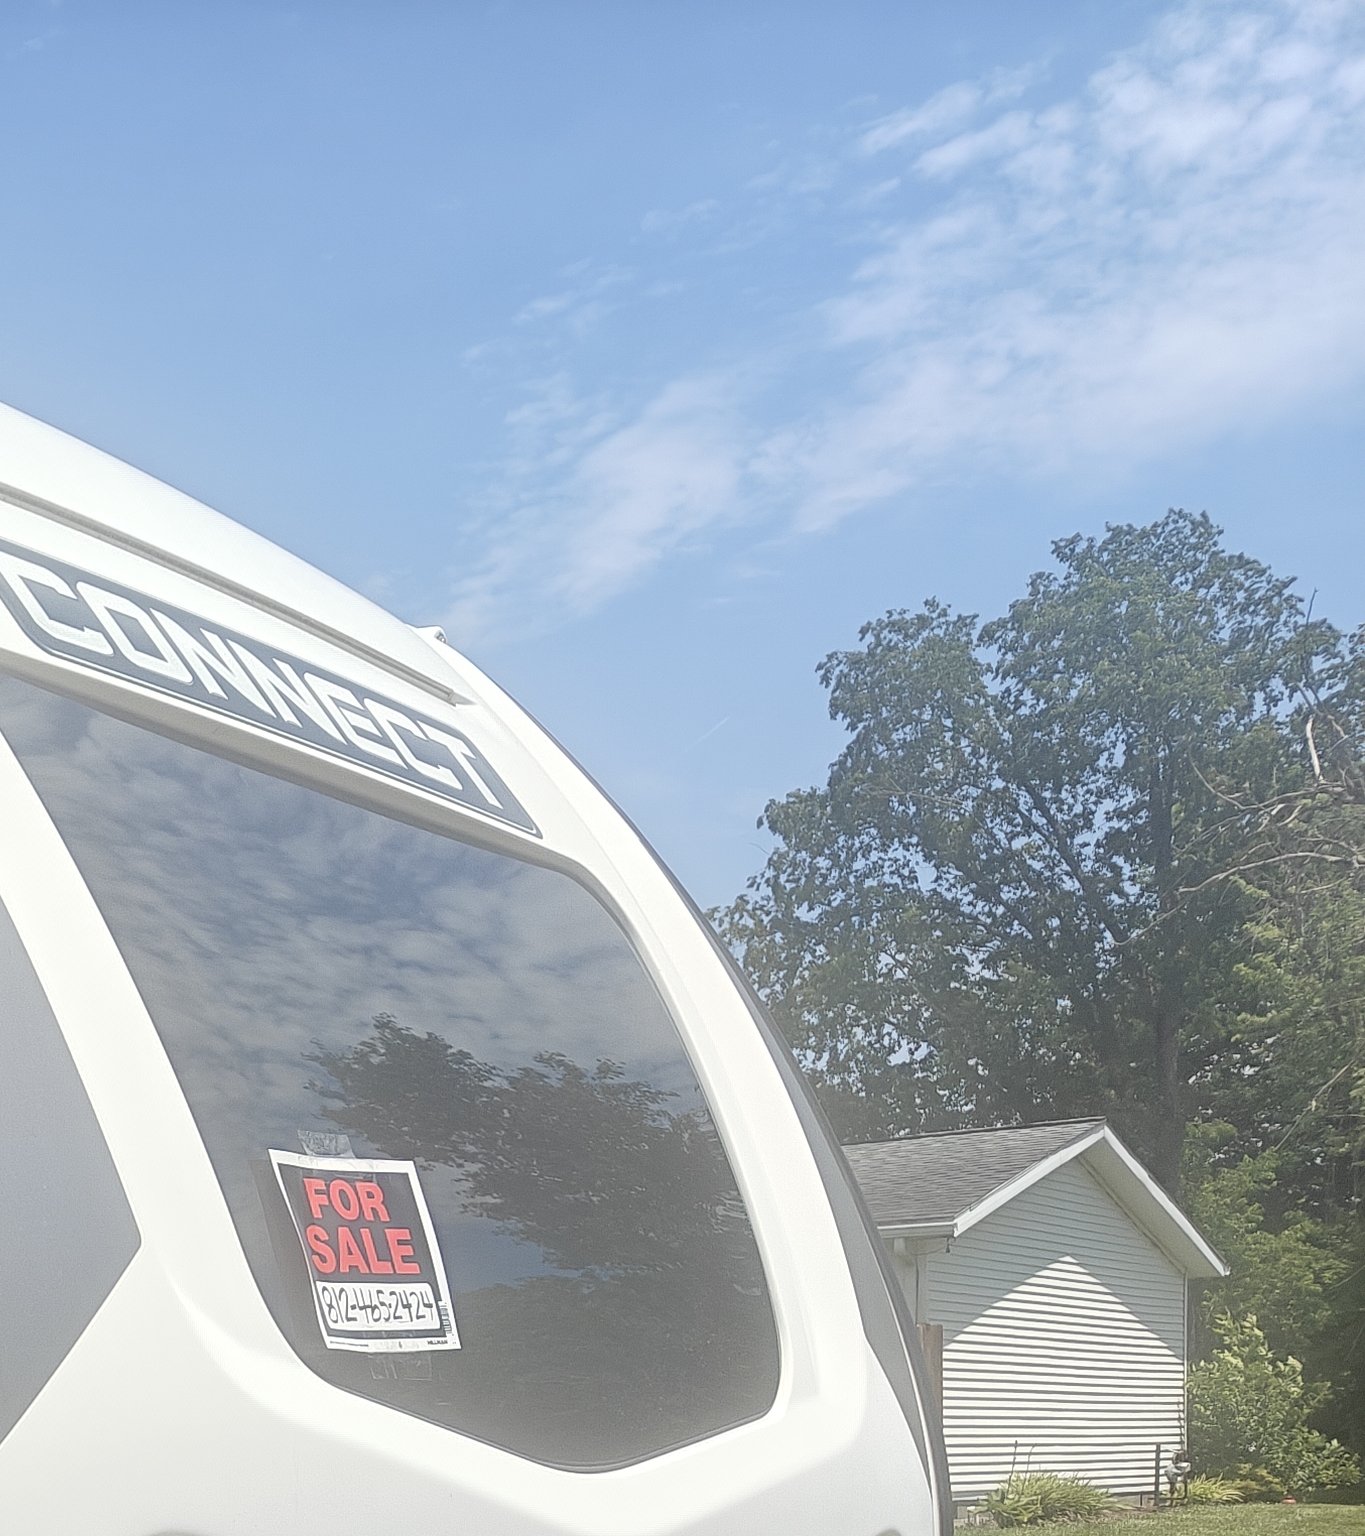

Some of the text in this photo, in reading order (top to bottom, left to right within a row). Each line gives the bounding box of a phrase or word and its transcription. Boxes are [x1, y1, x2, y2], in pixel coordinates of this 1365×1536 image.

[303, 1177, 390, 1222] FOR
[305, 1224, 421, 1275] SALE
[322, 1285, 434, 1324] 812-465-2424
